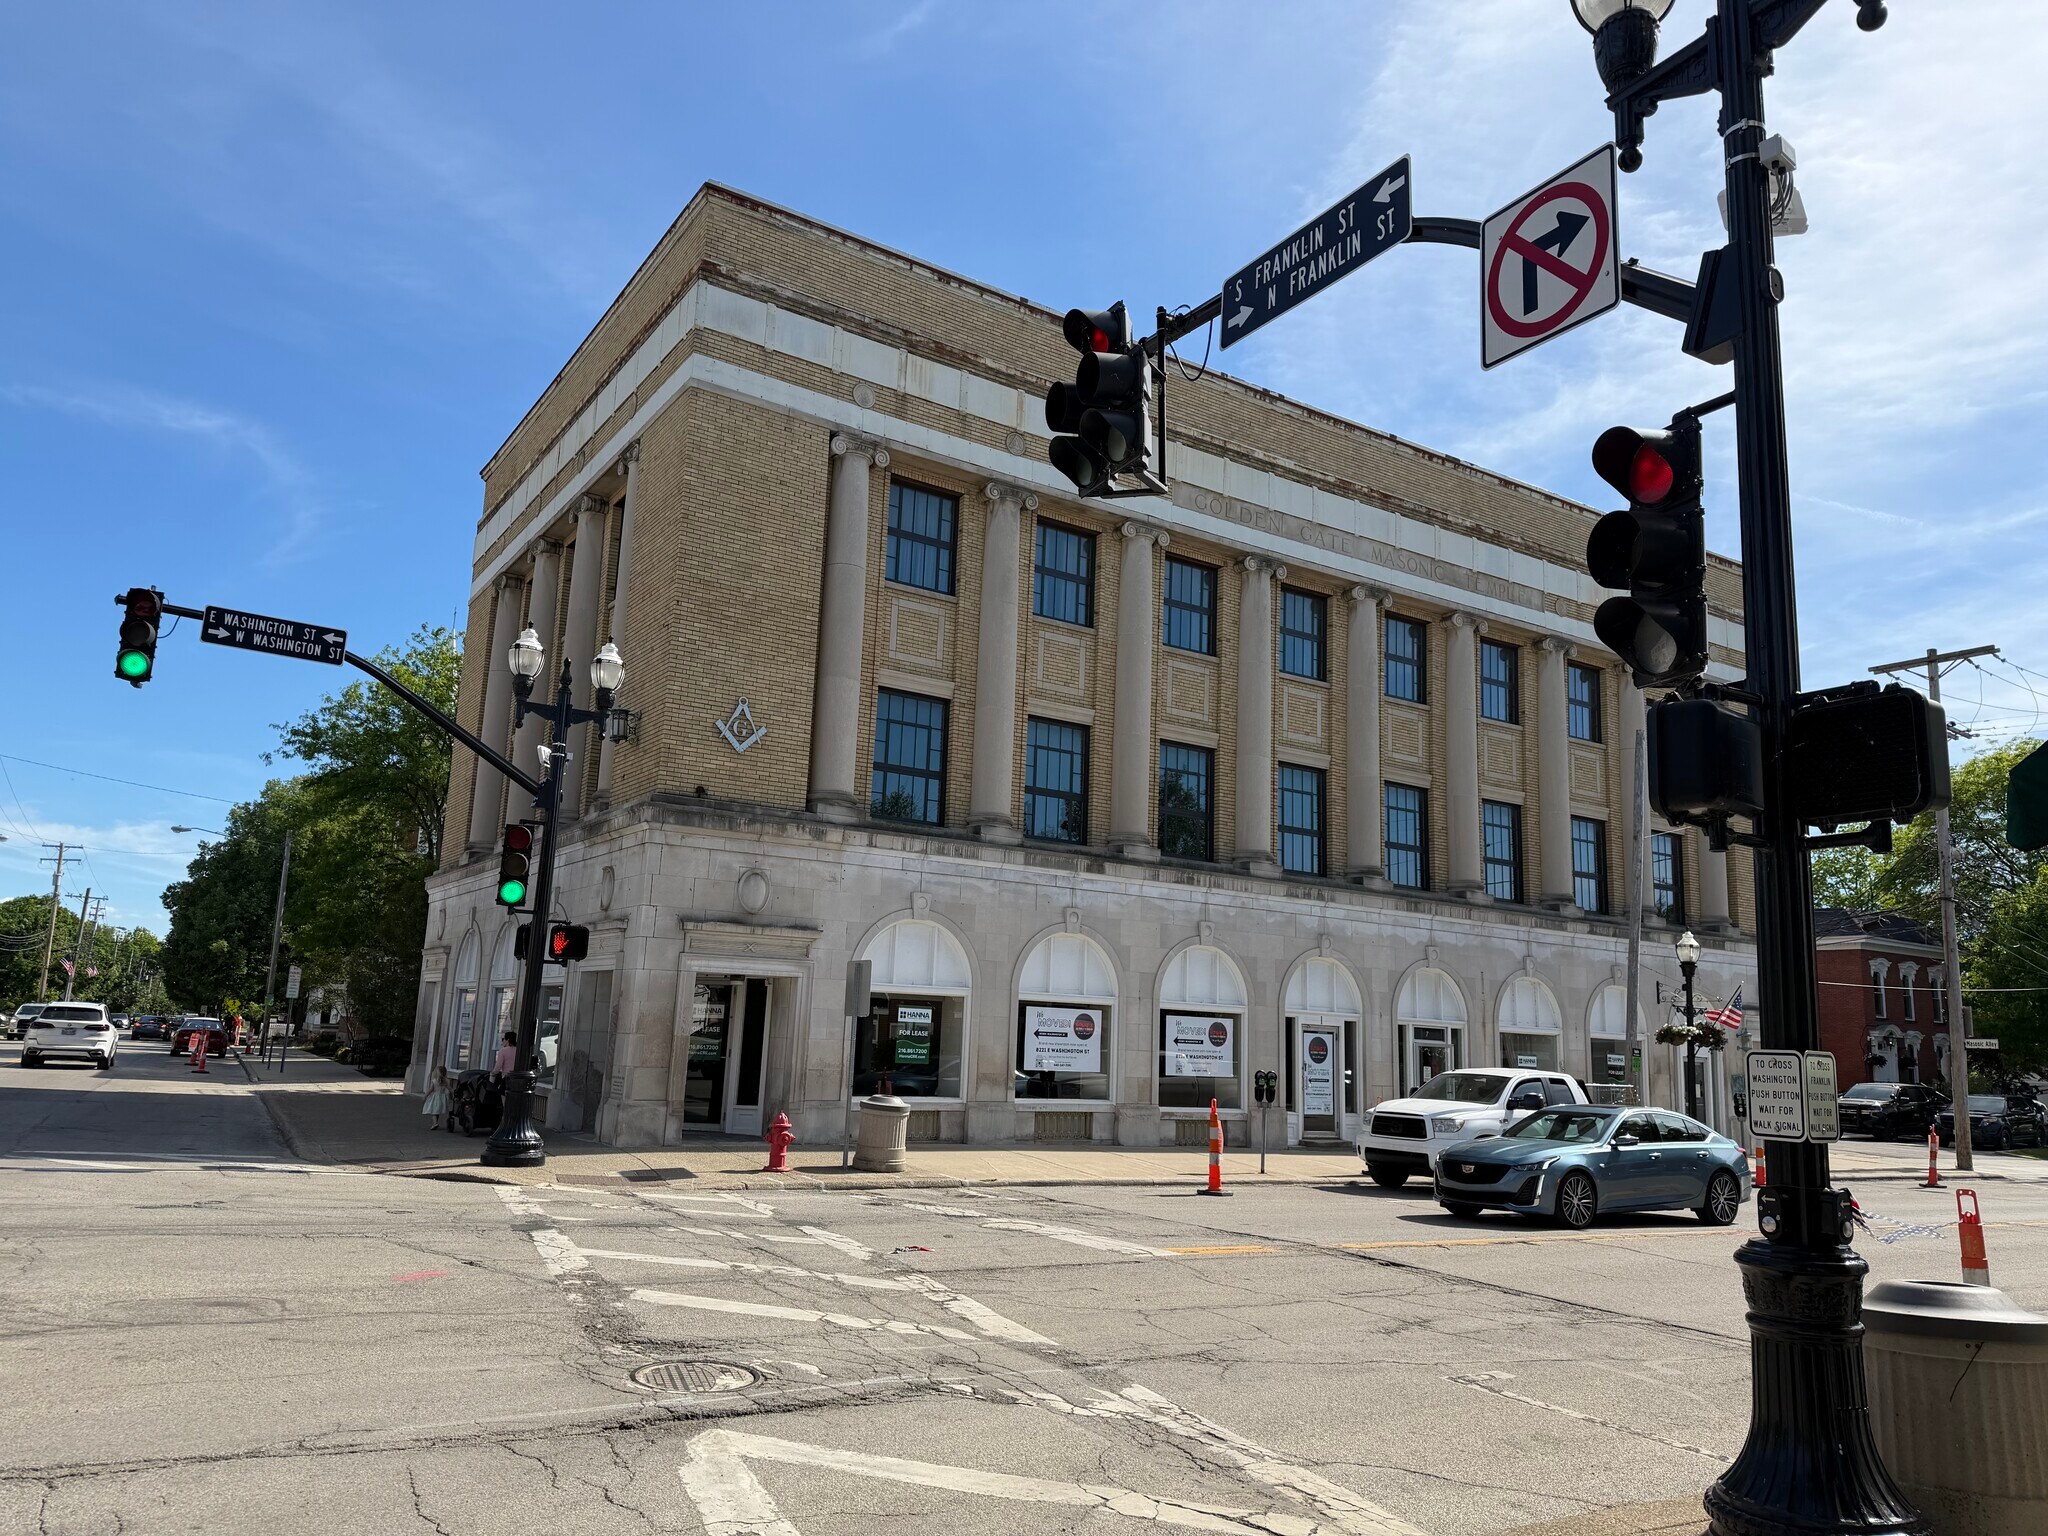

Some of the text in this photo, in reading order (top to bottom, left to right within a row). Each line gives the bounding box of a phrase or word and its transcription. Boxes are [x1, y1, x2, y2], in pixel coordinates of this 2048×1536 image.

[1234, 202, 1356, 302] S FRANKLIN ST
[1268, 208, 1395, 310] N FRANKLIN ST
[1194, 493, 1527, 603] GOLDEN GATE MASONIC TEMPLE
[209, 611, 316, 640] E WASHINGTON ST
[236, 630, 342, 660] W WASHINGTON ST
[733, 720, 747, 737] G
[1756, 1060, 1792, 1070] TO CROSS
[1810, 1062, 1816, 1070] TO
[1752, 1075, 1797, 1084] WASHINGTON
[1811, 1077, 1831, 1086] FRANKLIN
[1752, 1089, 1800, 1100] PUSH BUTTON
[1808, 1092, 1835, 1101] PUSH BUTTON
[1759, 1105, 1794, 1115] WAIT FOR
[1813, 1108, 1832, 1117] WAIT FOR
[1753, 1120, 1801, 1131] WALK SIGNAL
[1810, 1124, 1821, 1132] WALK
